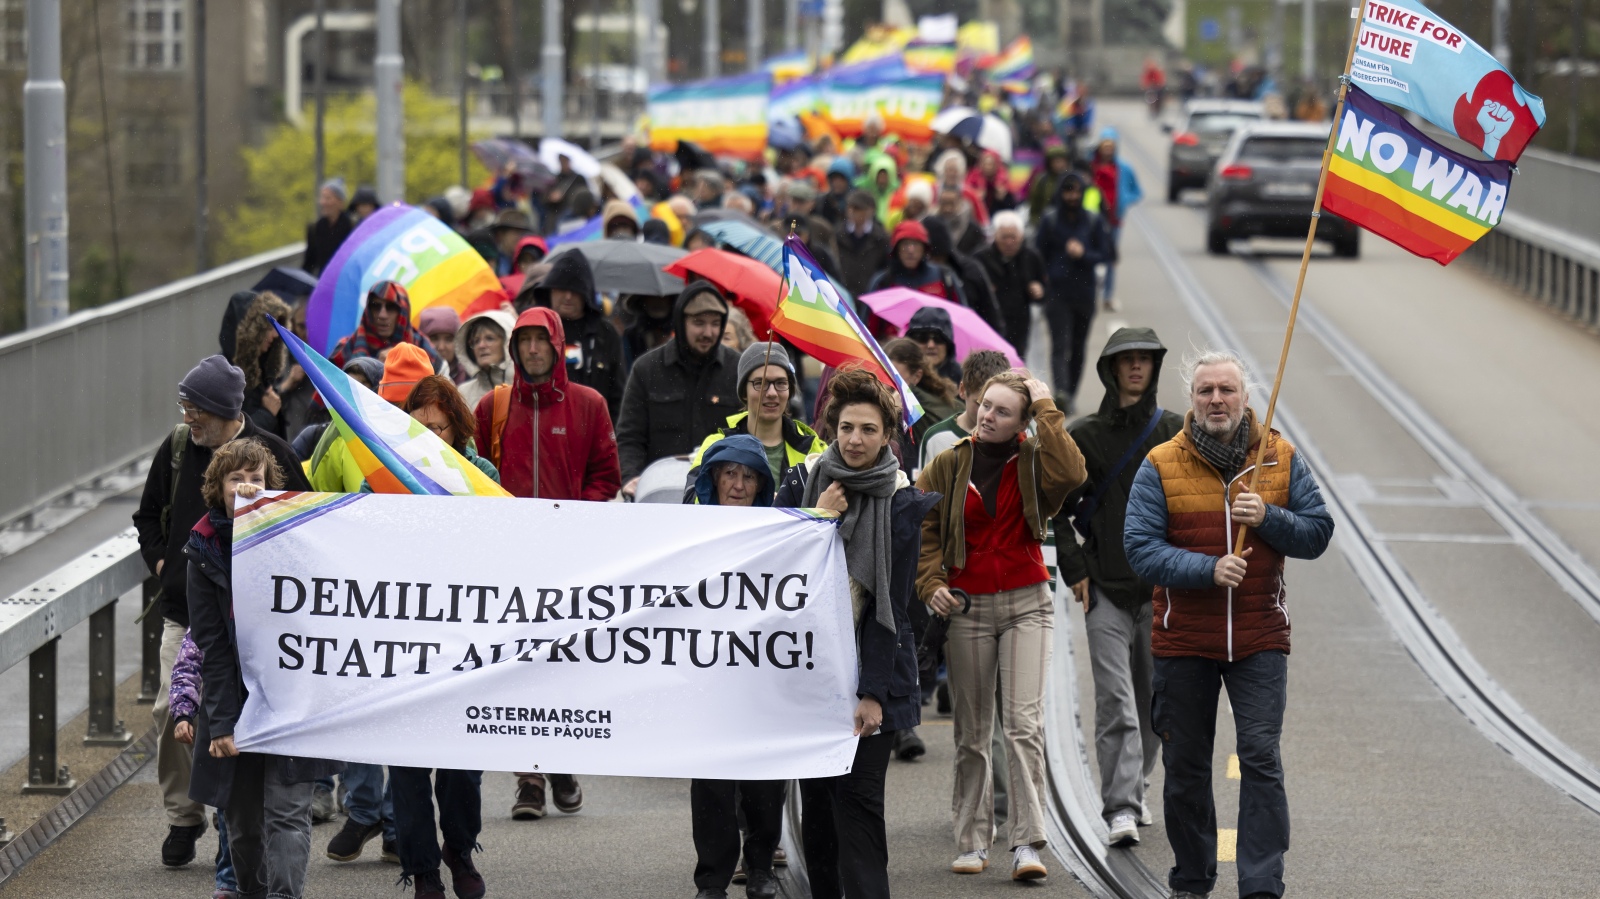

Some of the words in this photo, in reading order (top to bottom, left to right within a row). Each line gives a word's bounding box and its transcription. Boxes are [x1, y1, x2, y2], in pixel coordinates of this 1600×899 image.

[1420, 21, 1462, 48] FOR
[1377, 63, 1390, 72] FÜR
[1336, 109, 1408, 174] NO
[1411, 147, 1507, 226] WAR
[271, 572, 809, 624] DEMILITARISIERUNG
[278, 633, 441, 678] STATT
[465, 705, 612, 724] OSTERMARSCH
[466, 723, 527, 736] MARCHE
[531, 726, 550, 737] DE
[554, 724, 612, 740] PÂQUES
